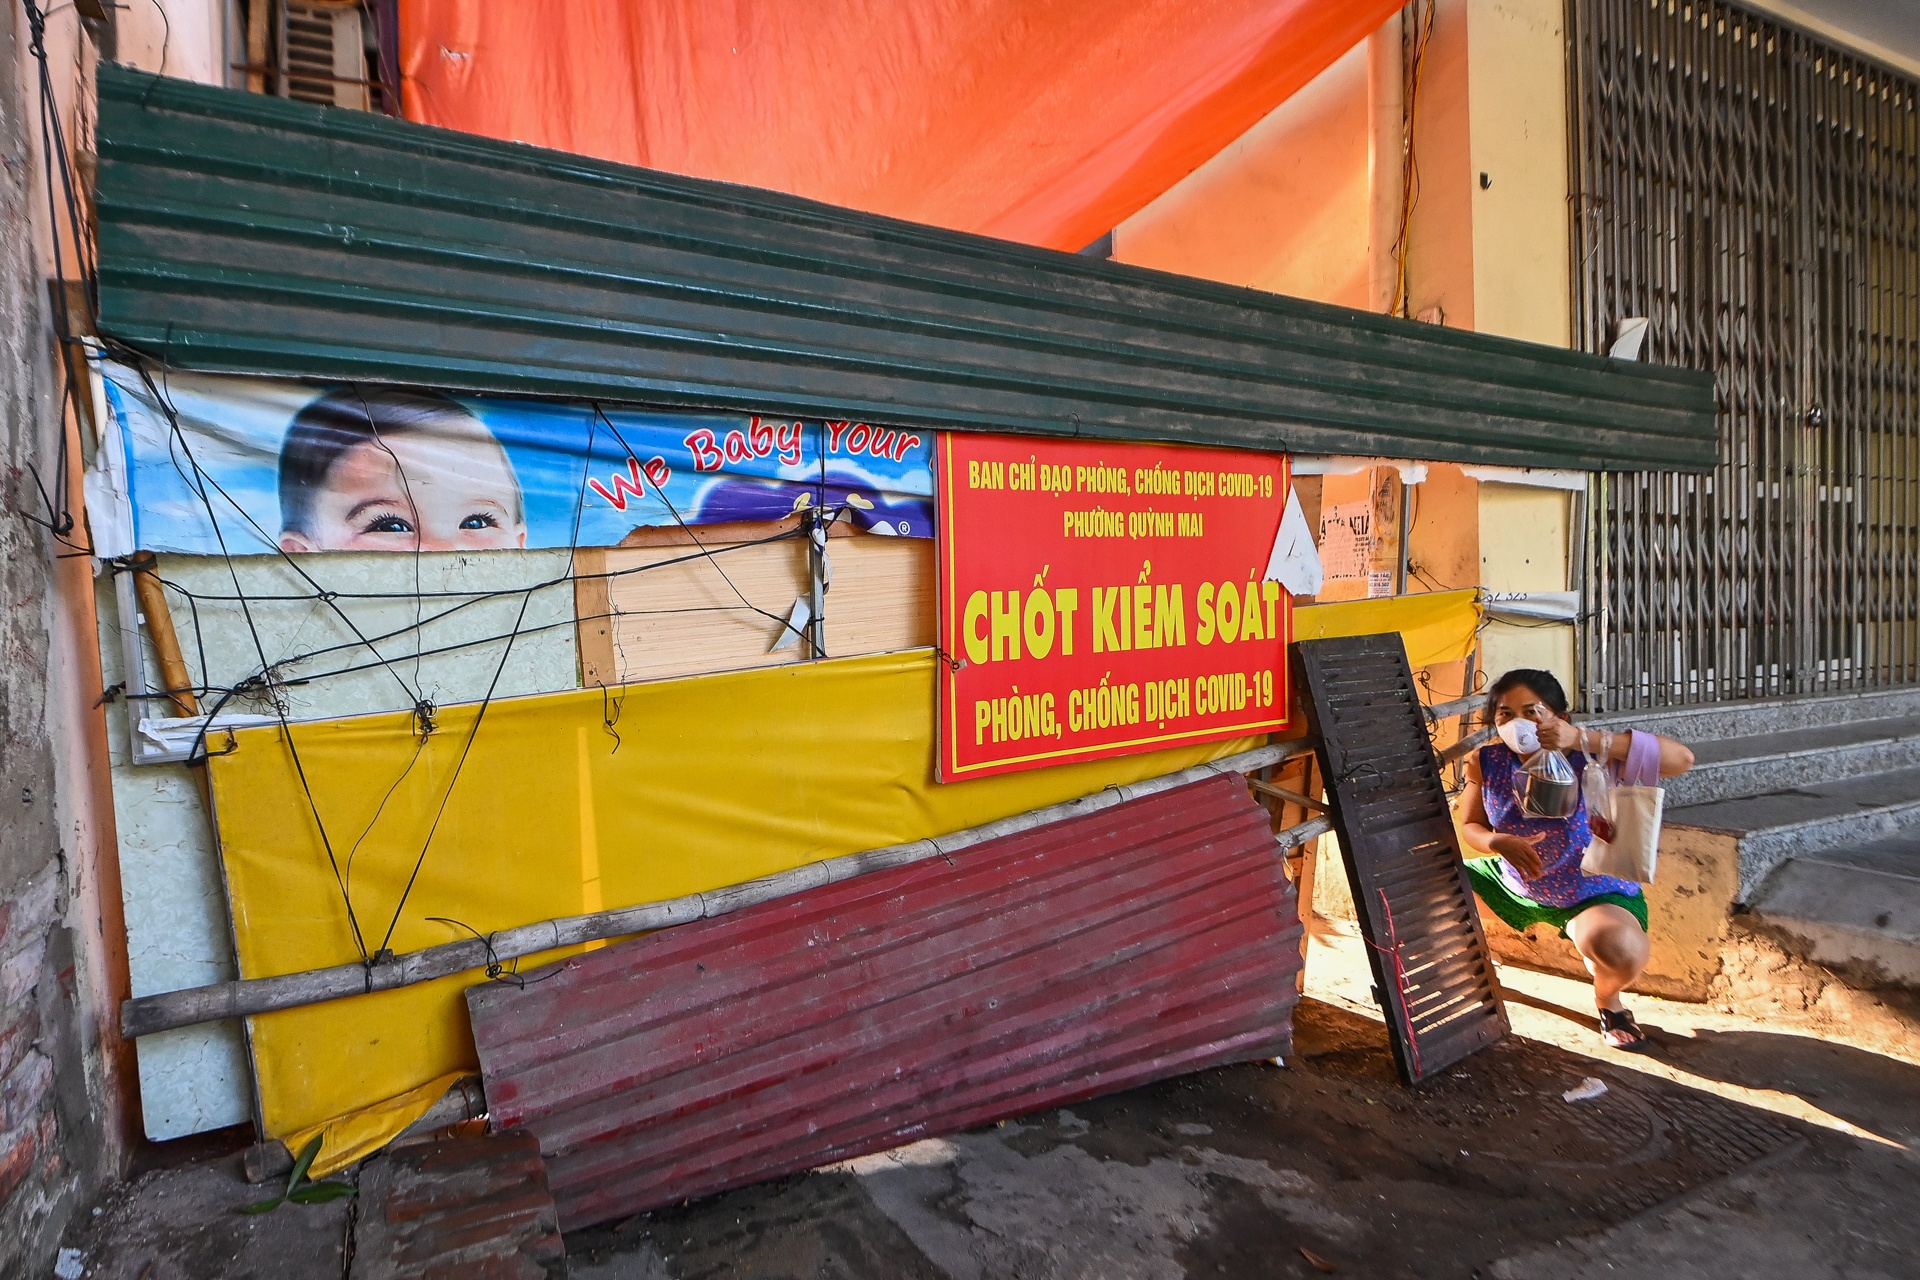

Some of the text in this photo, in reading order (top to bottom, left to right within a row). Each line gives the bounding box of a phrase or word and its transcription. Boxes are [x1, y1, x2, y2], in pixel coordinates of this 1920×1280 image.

[588, 416, 921, 512] We Baby Your
[968, 455, 1273, 501] BAN CHỈ ĐẠO PHÒNG, CHỐNG DỊCH COVID-19
[1063, 506, 1204, 540] PHƯỜNG QUỲNH MAI
[962, 559, 1279, 665] CHỐT KIỂM SOÁT
[975, 670, 1273, 746] PHÒNG, CHỐNG DỊCH COVID-19
